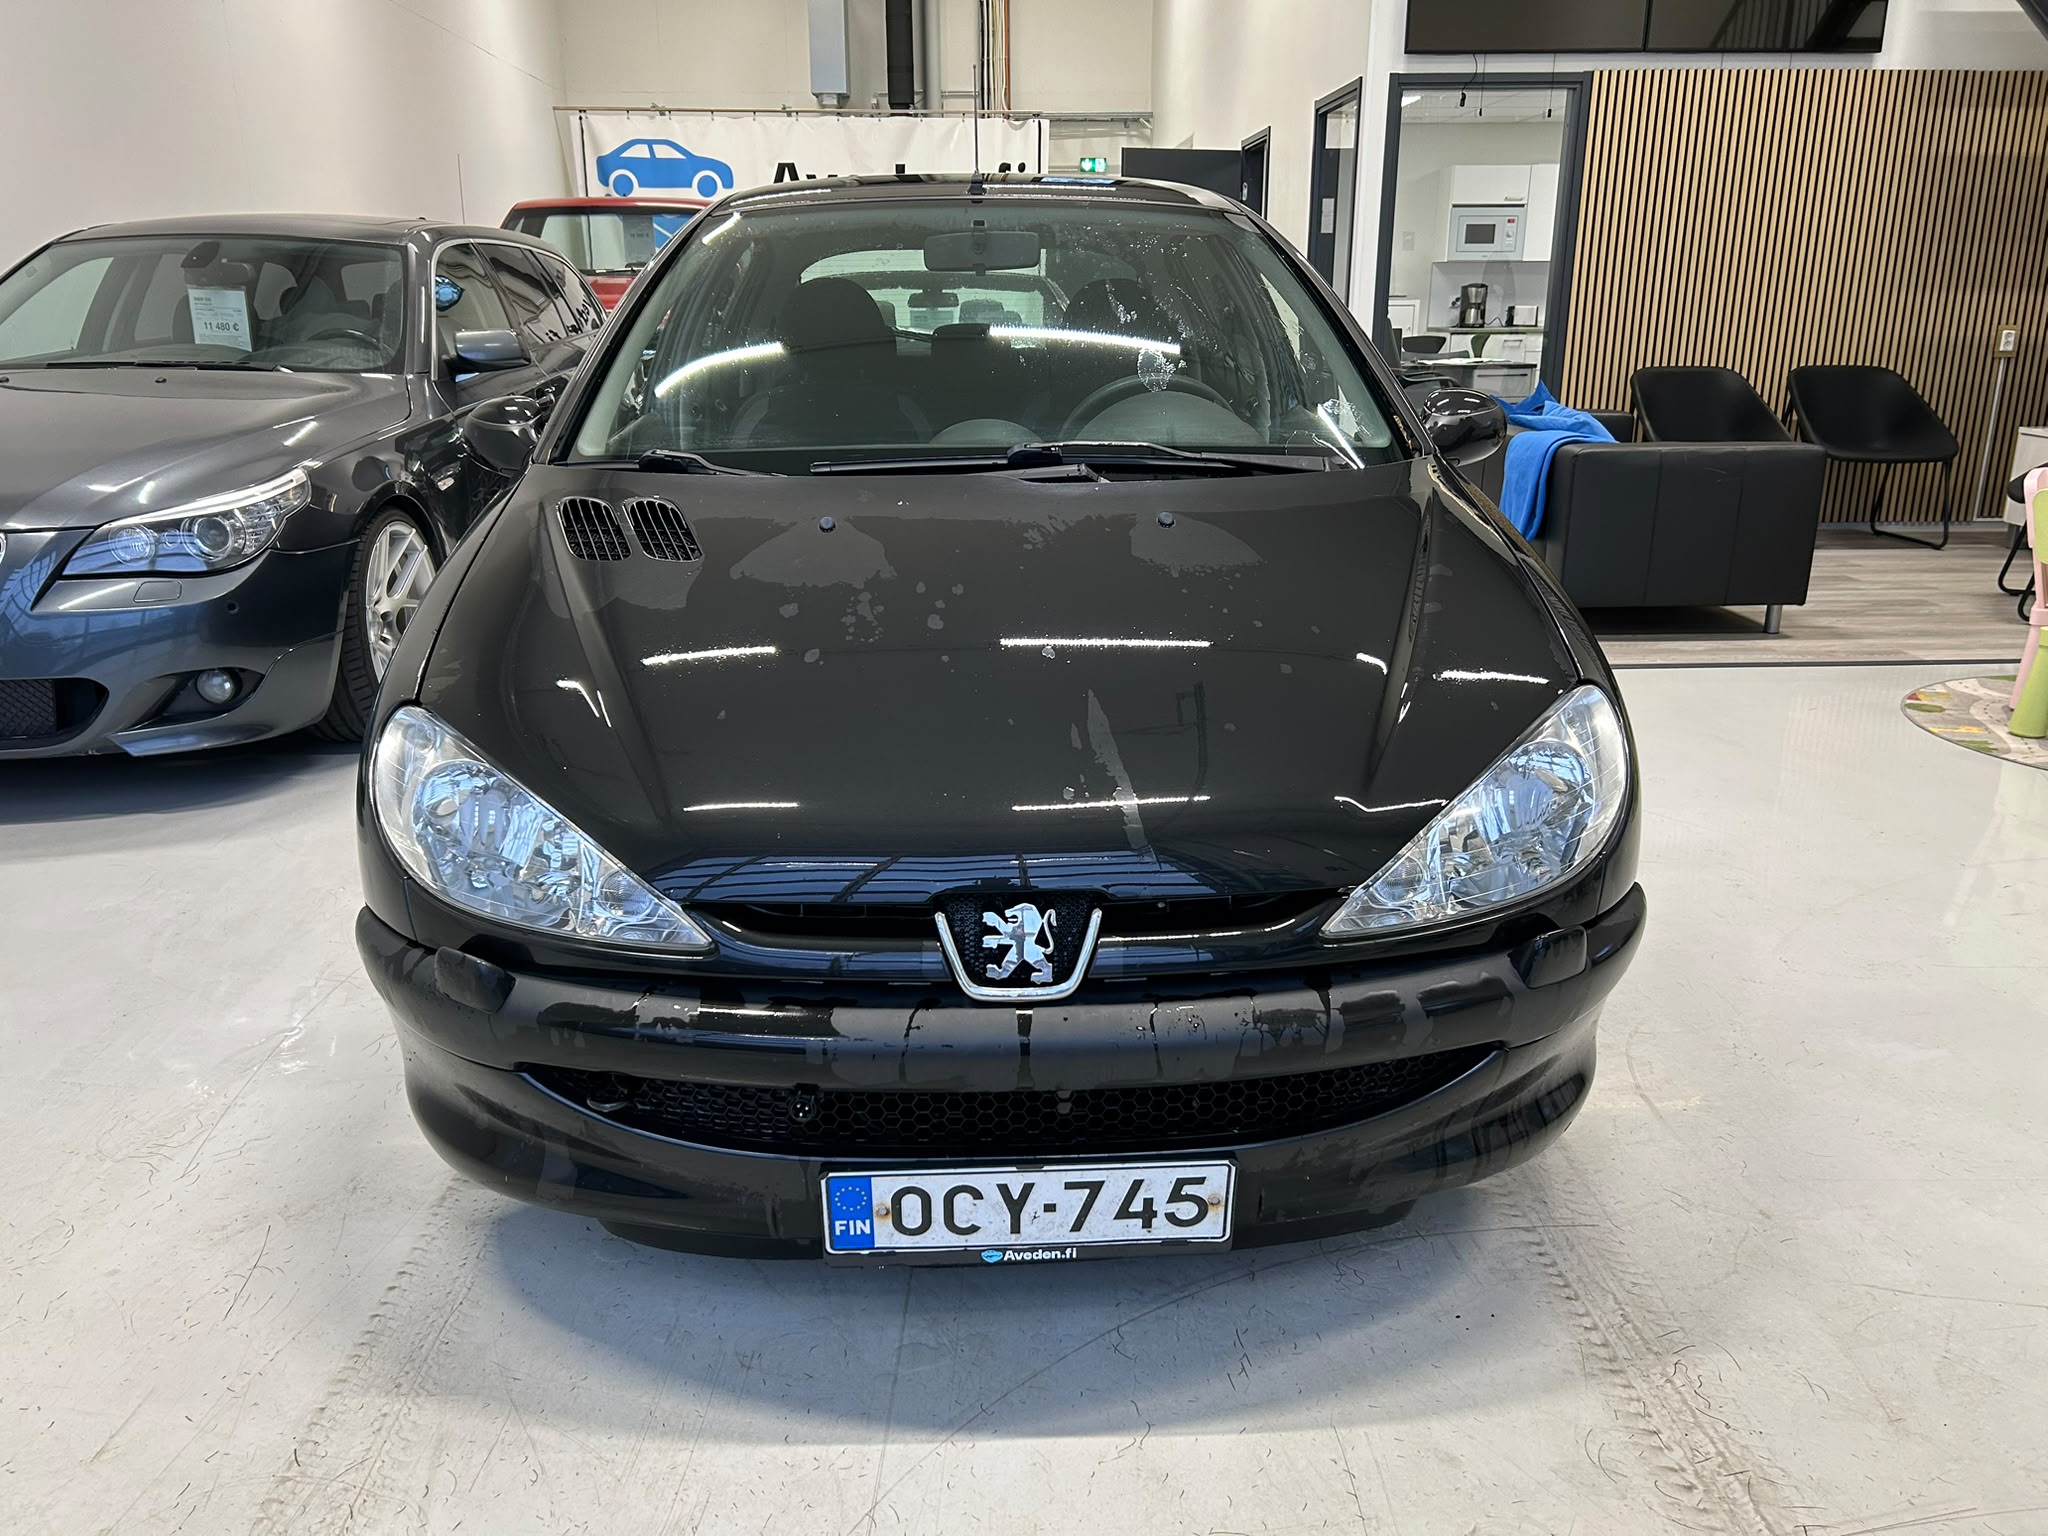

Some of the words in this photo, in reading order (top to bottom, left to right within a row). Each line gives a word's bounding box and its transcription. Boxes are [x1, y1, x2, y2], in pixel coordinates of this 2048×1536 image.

[204, 322, 213, 331] 11
[215, 322, 231, 331] 480
[232, 322, 240, 332] €
[890, 1176, 1209, 1237] OCY-745
[834, 1219, 871, 1236] FIN
[1003, 1247, 1077, 1261] Aveden.fi
